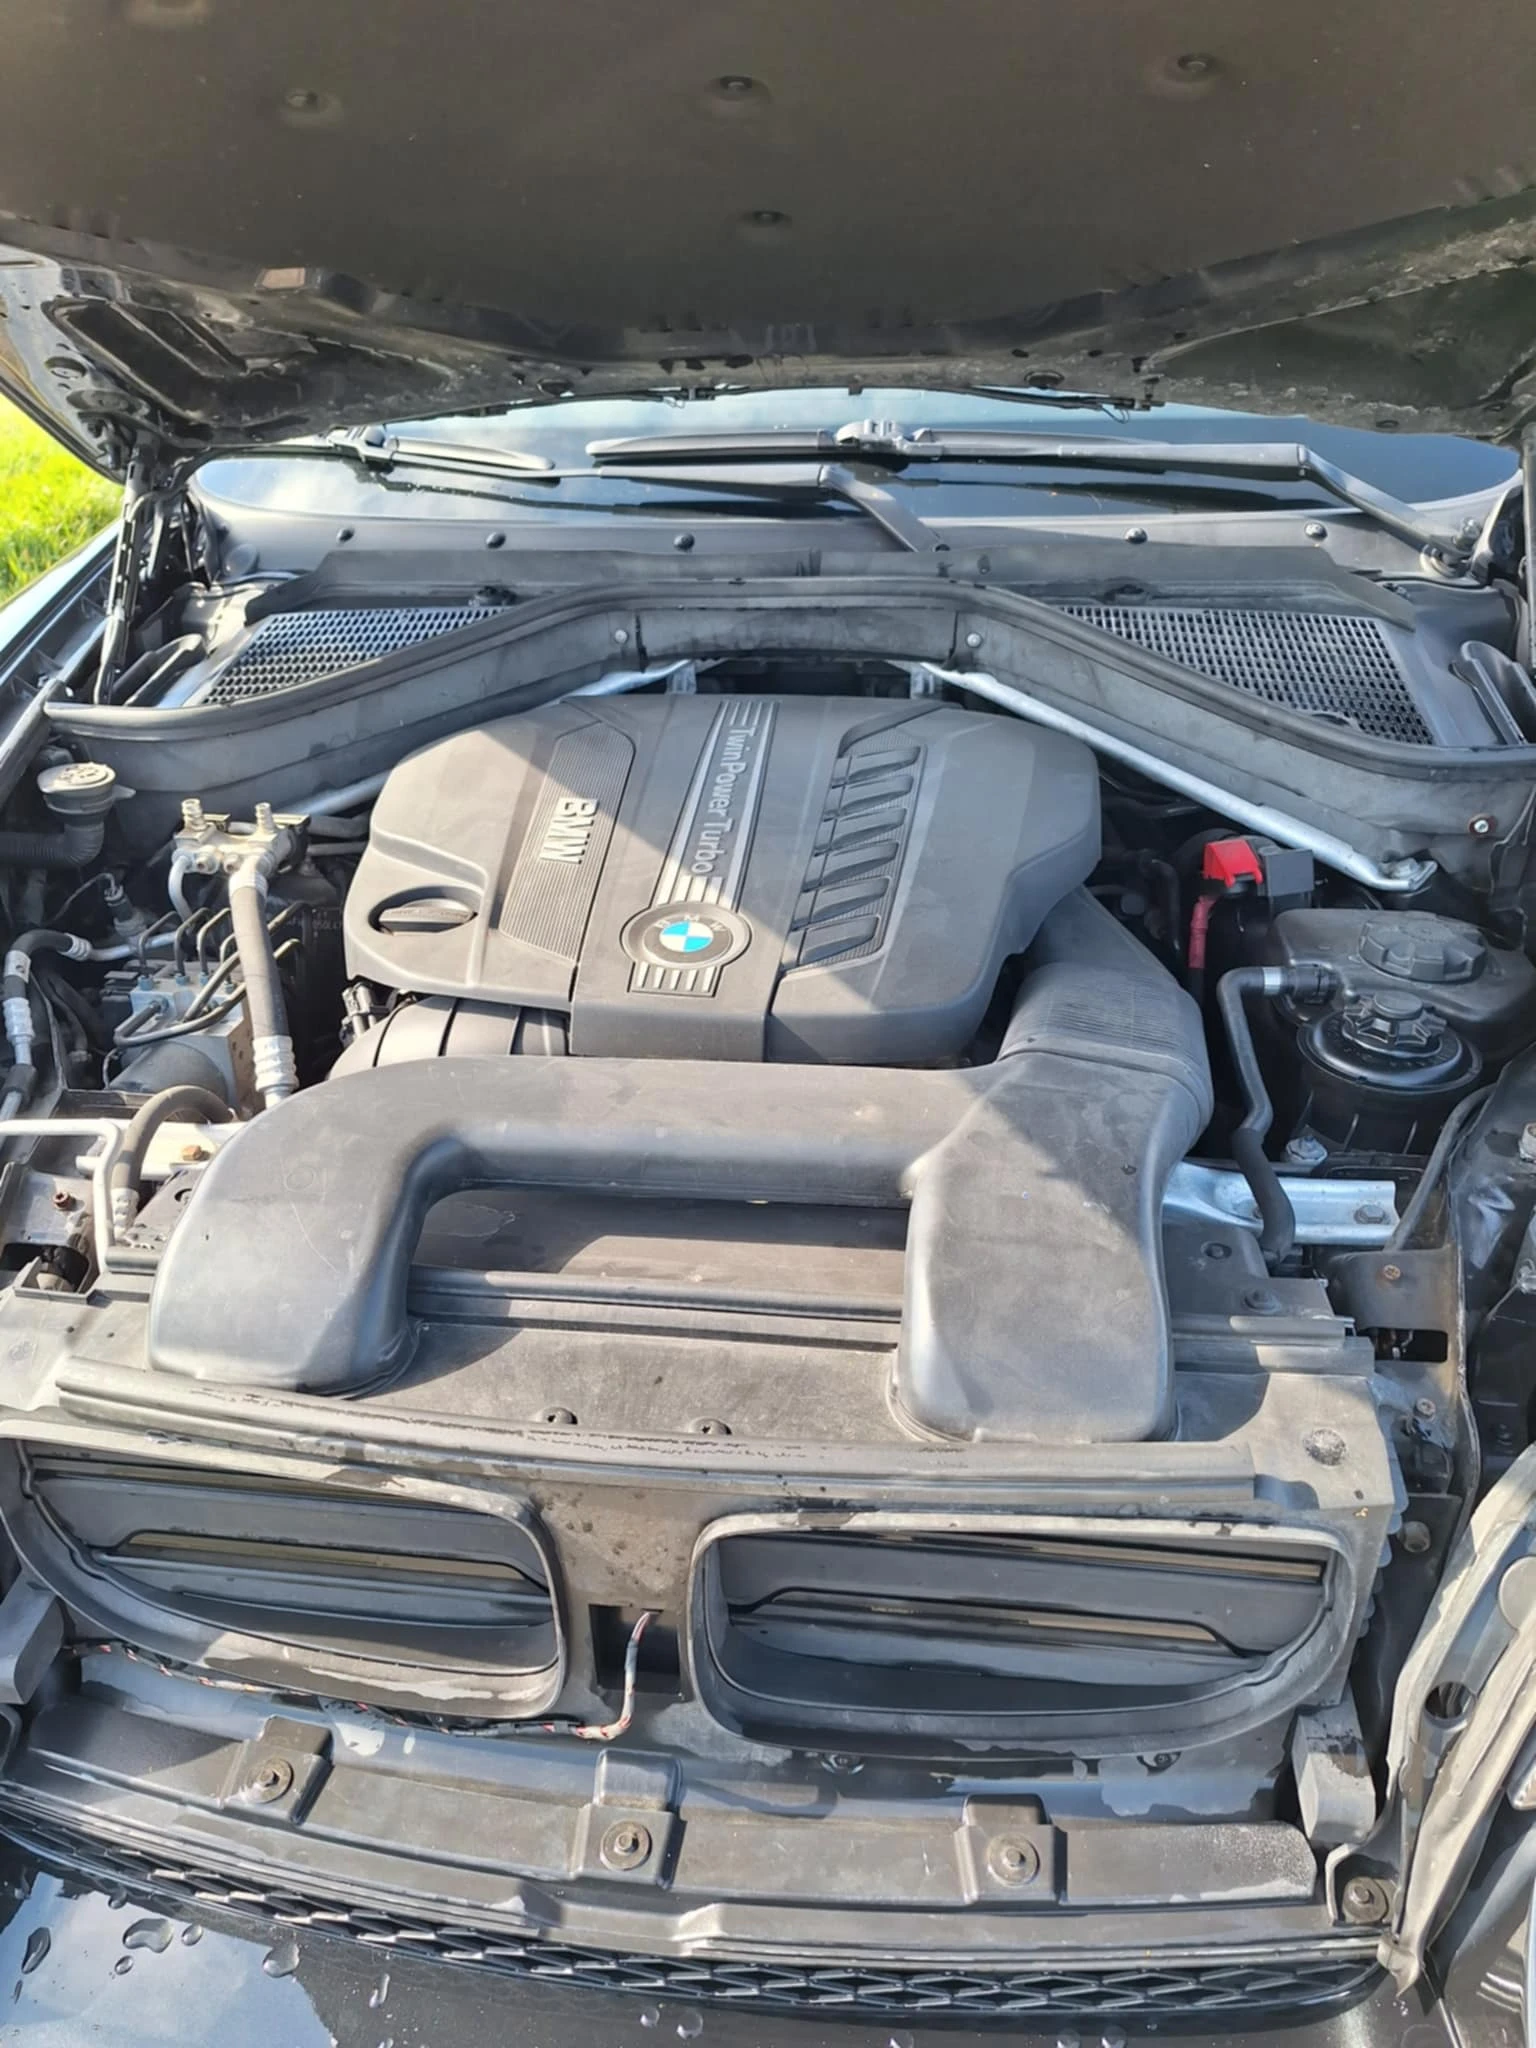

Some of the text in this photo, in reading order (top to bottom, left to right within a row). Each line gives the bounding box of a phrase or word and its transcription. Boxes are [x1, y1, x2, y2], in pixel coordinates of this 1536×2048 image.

[539, 797, 598, 864] BMW
[691, 727, 756, 874] TwinPower Turbo
